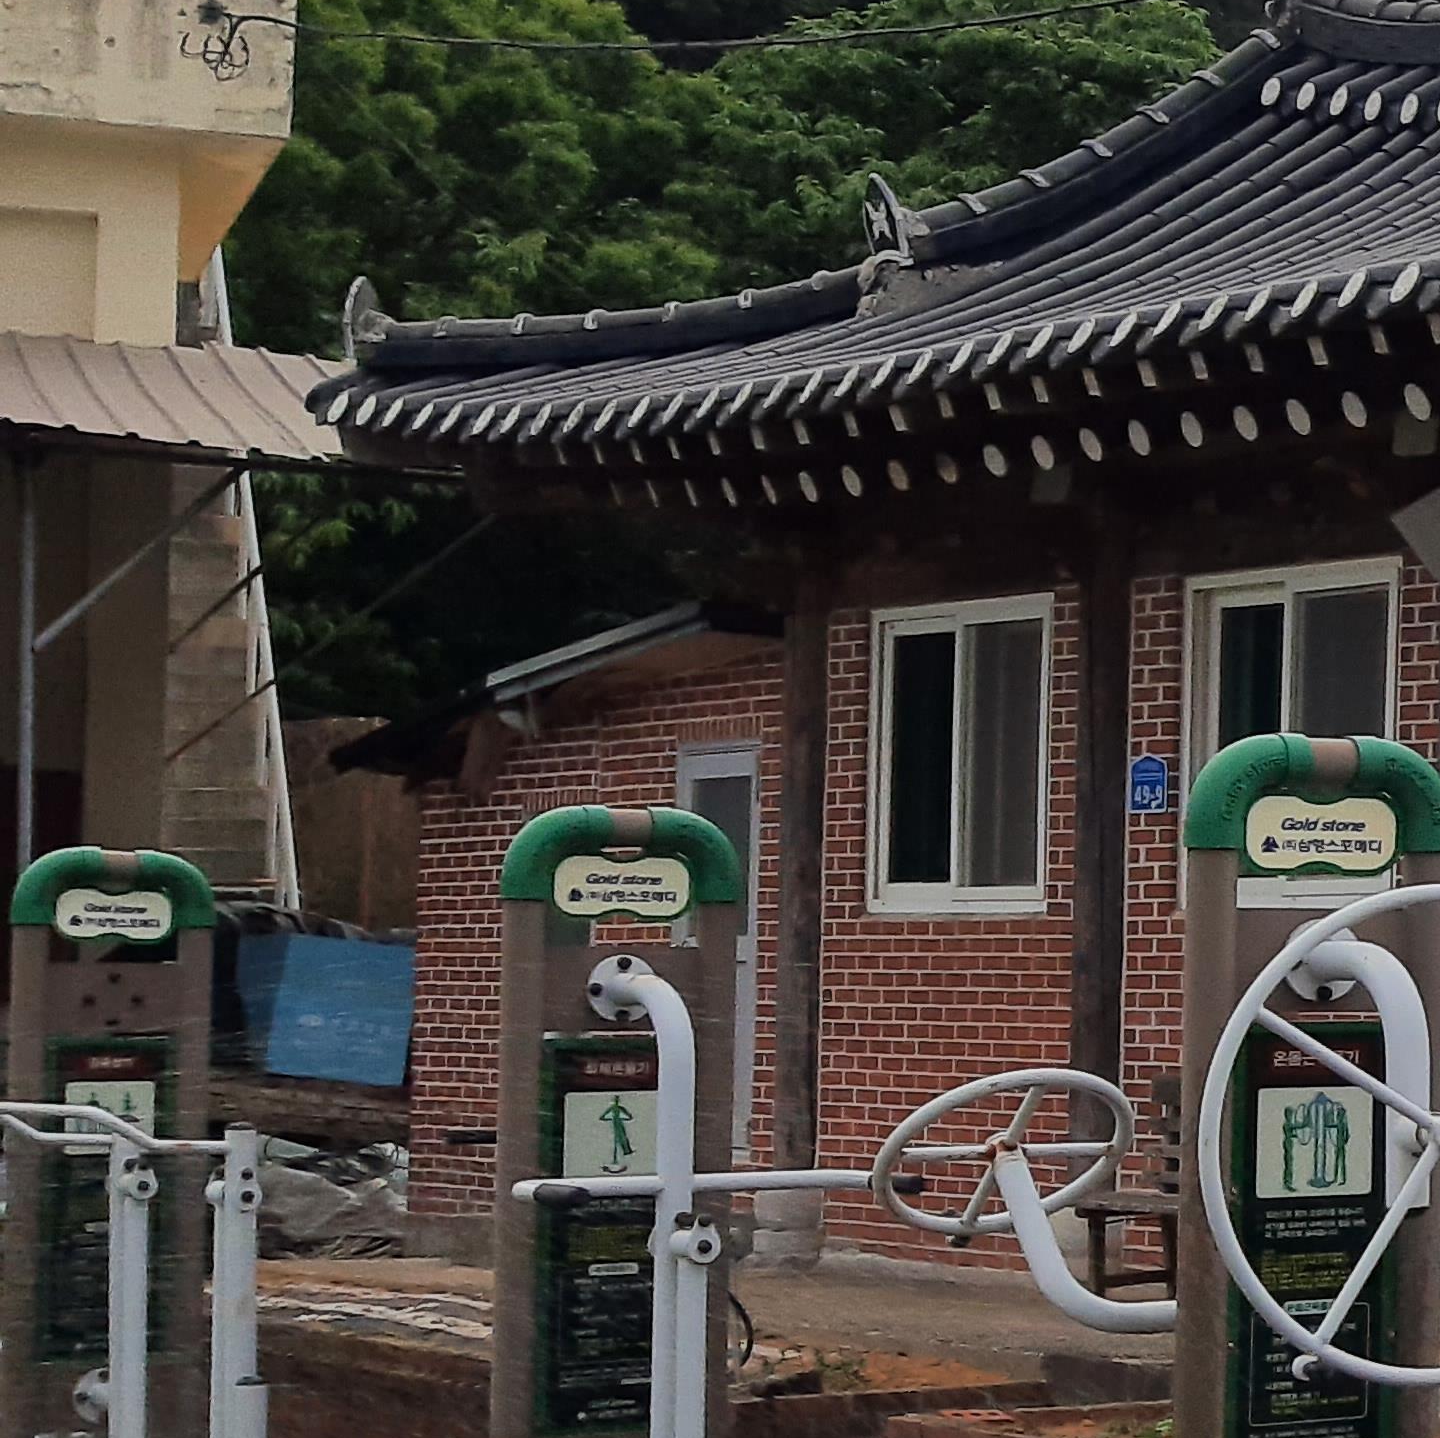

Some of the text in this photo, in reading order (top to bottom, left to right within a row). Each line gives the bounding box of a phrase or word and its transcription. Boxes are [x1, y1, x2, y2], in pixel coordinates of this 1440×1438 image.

[1280, 816, 1367, 833] Gold stone
[585, 872, 663, 886] Gold stone
